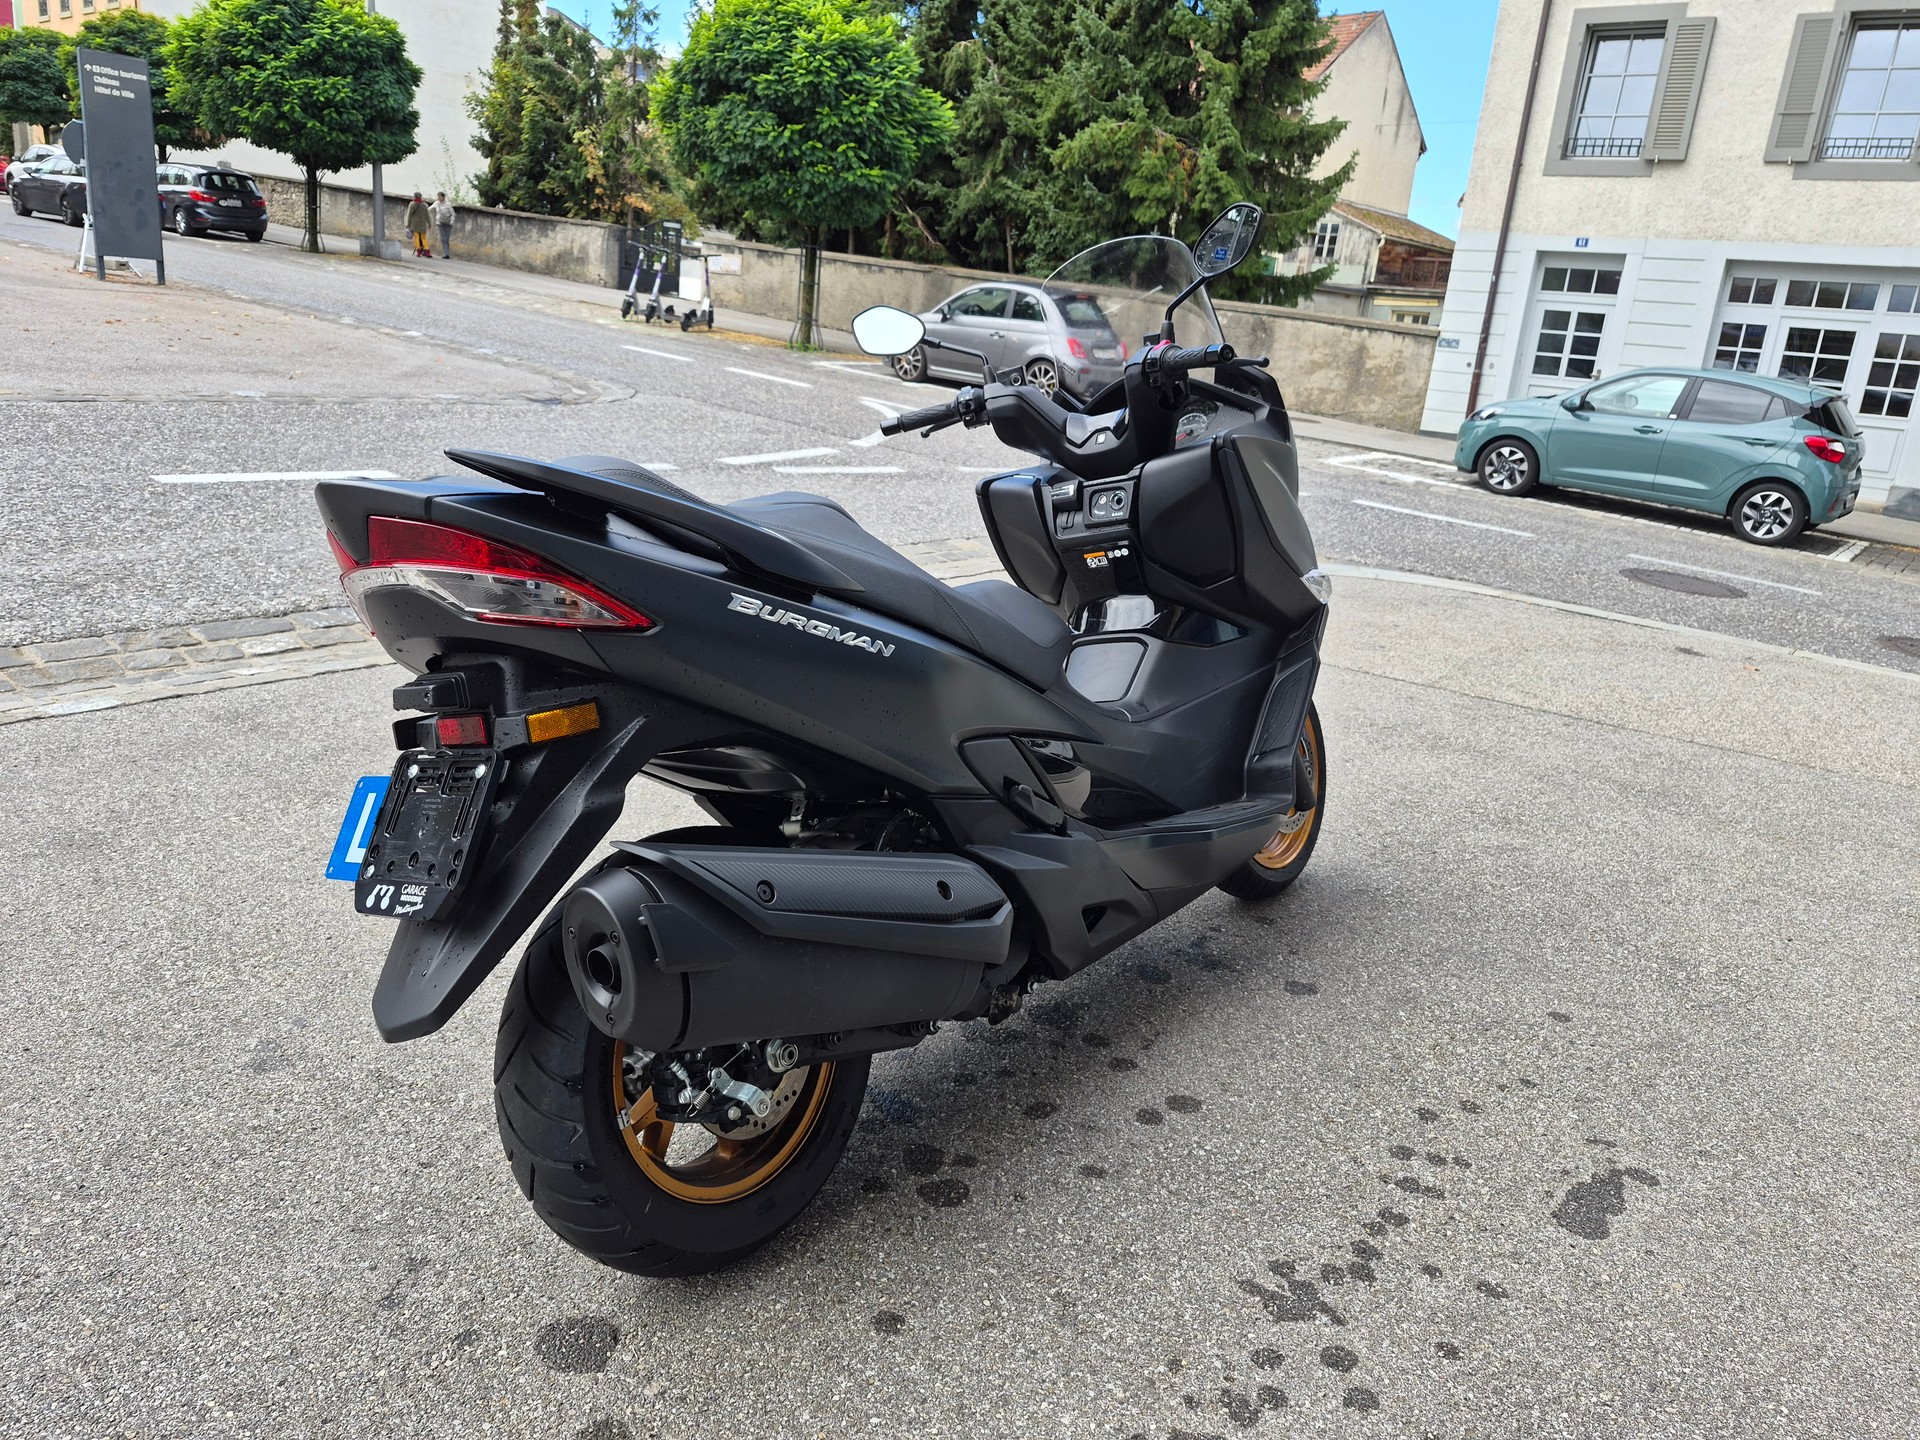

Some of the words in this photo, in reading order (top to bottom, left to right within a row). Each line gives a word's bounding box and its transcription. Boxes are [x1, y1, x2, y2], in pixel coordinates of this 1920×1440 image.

[101, 66, 119, 76] Office
[120, 70, 147, 81] tourisme
[120, 89, 135, 99] Ville
[727, 592, 896, 657] BURGMAN
[345, 792, 376, 864] L
[401, 884, 428, 896] GARAGE
